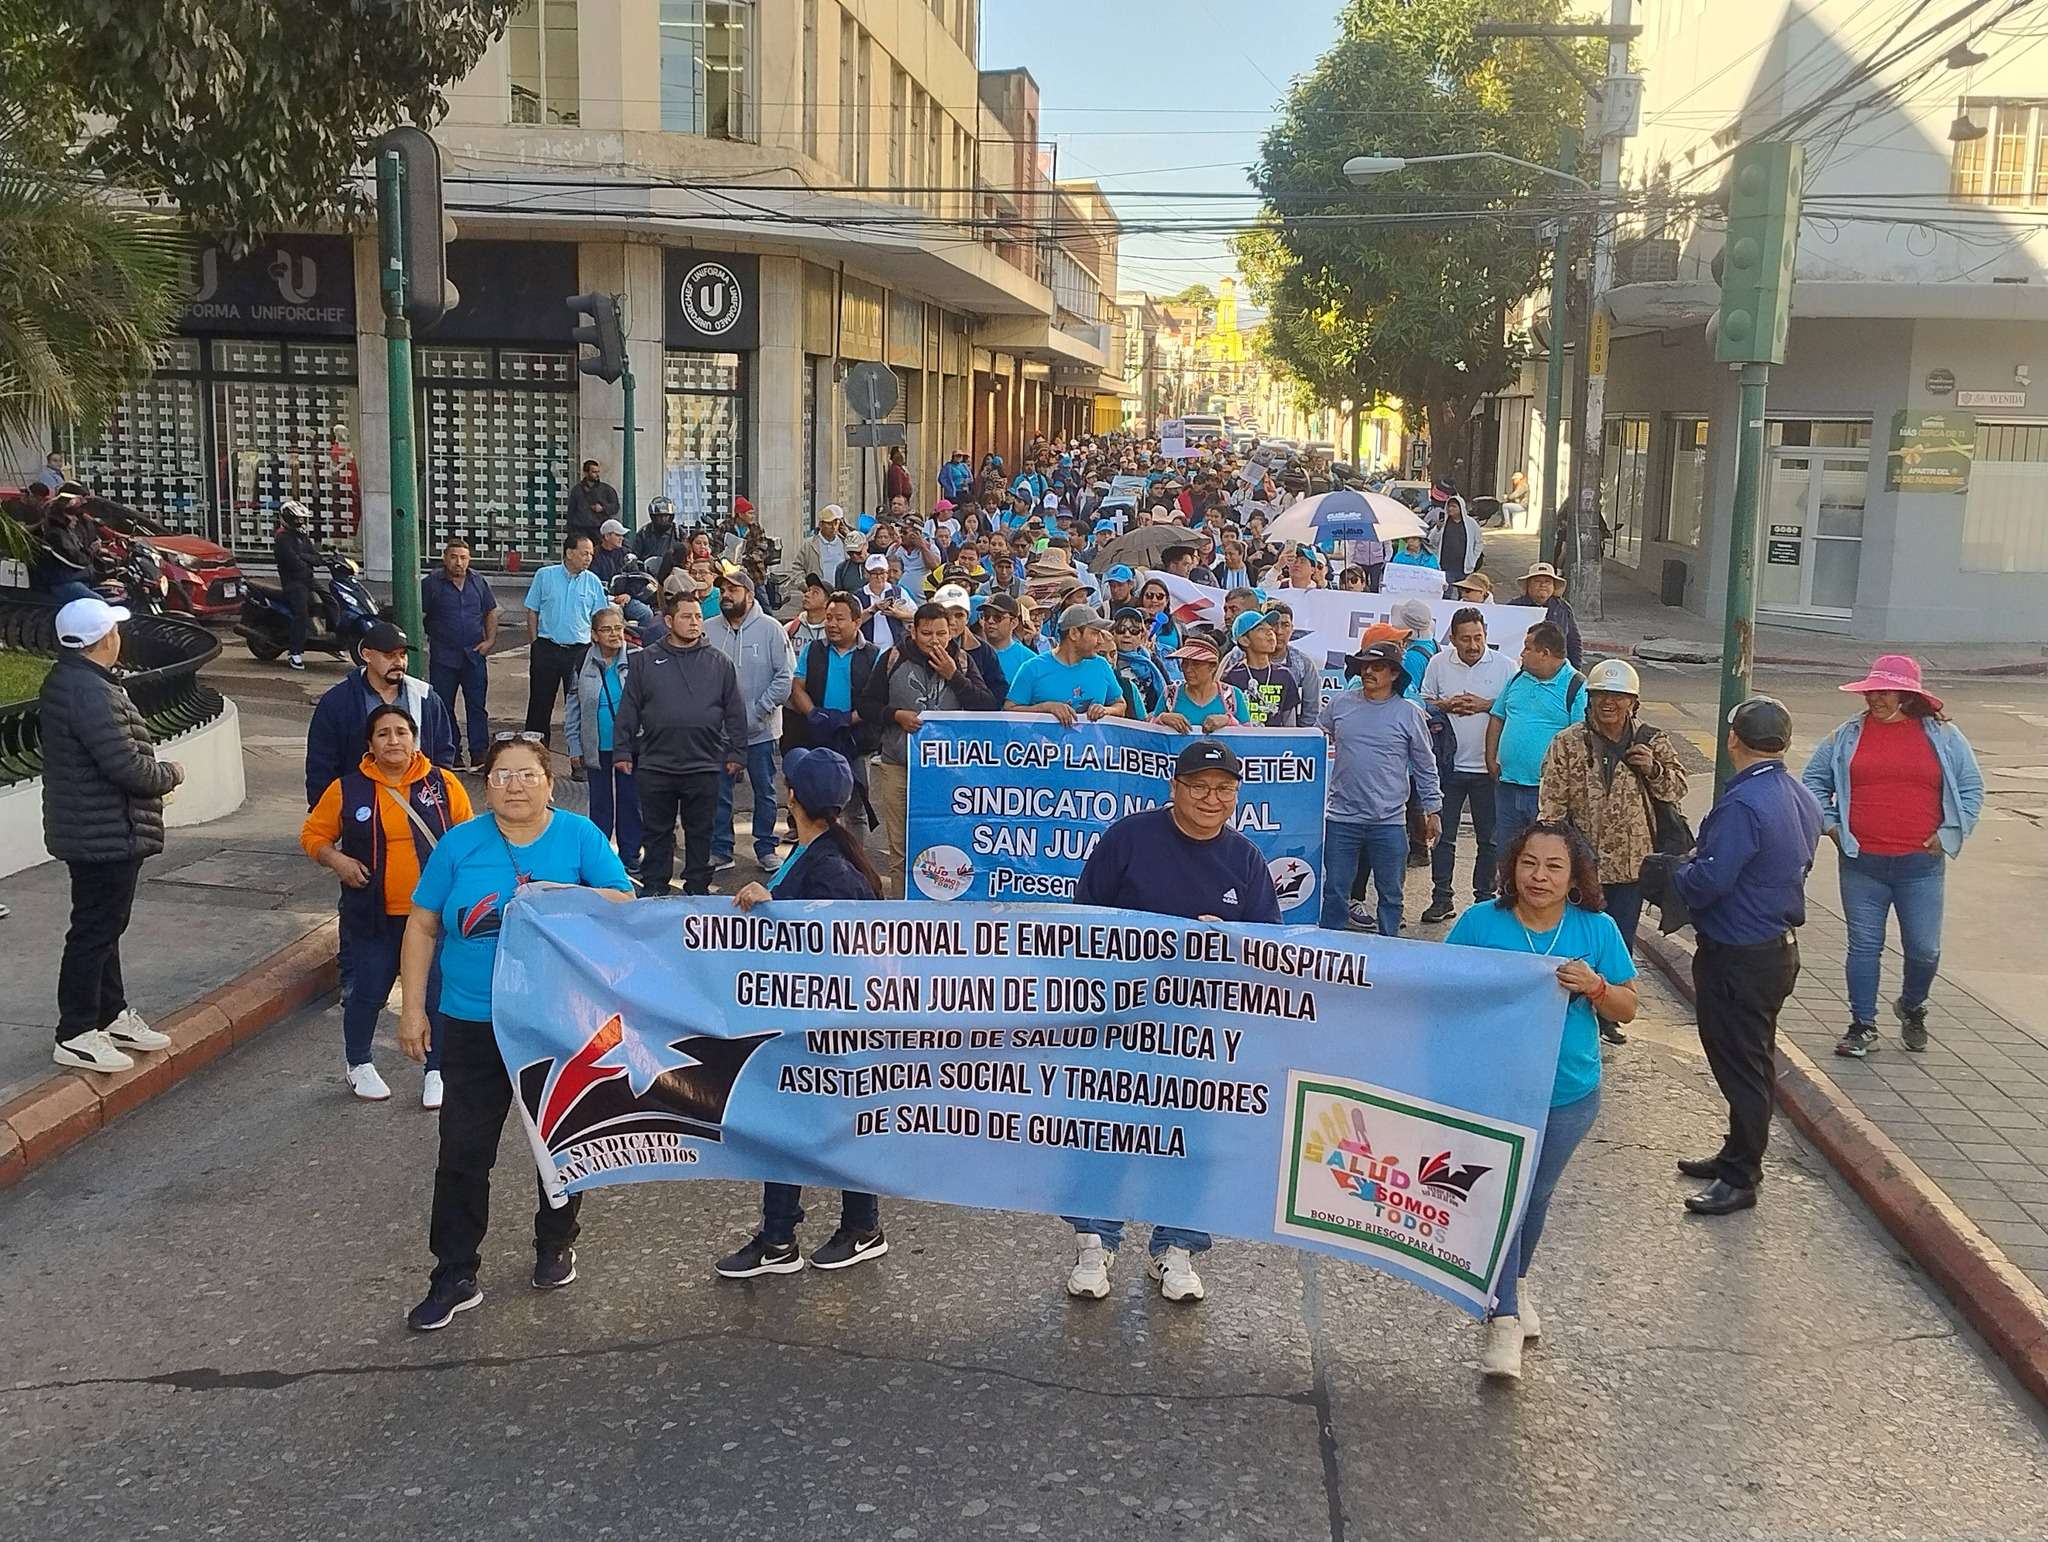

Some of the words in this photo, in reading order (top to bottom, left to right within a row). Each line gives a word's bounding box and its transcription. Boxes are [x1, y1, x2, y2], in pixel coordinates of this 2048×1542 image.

[691, 267, 730, 284] UNIFORMA
[251, 305, 345, 322] UNIFORCHEF
[684, 282, 712, 330] UNIFORCHEF
[1259, 685, 1283, 694] GET
[920, 740, 1000, 768] FILIAL
[1004, 741, 1060, 769] CAP
[1064, 744, 1101, 771] LA
[1103, 745, 1178, 780] LIBERT
[952, 786, 1117, 821] SINDICATO
[972, 824, 1038, 858] SAN
[1044, 828, 1101, 860] JUA
[988, 867, 1080, 898] ¡Presen
[685, 915, 824, 954] SINDICATO
[832, 920, 968, 957] NACIONAL
[975, 920, 1010, 957] DE
[1017, 921, 1178, 961] EMPLEADOS
[1184, 930, 1236, 963] DEL
[1242, 936, 1373, 989] HOSPITAL
[737, 971, 858, 1012] GENERAL
[864, 976, 920, 1012] SAN
[927, 976, 995, 1012] JUAN
[1003, 976, 1038, 1013] DE
[1045, 977, 1106, 1013] DIOS
[1113, 979, 1149, 1014] DE
[1154, 975, 1317, 1023] GUATEMALA
[807, 1028, 962, 1056] MINISTERIO
[970, 1028, 1005, 1050] DE
[1012, 1026, 1098, 1050] SALUD
[1104, 1021, 1216, 1062] PUBLICA
[1222, 1029, 1242, 1063] Y
[778, 1062, 932, 1098] ASISTENCIA
[939, 1061, 1032, 1096] SOCIAL
[1039, 1064, 1058, 1097] Y
[1063, 1066, 1270, 1116] TRABAJADORES
[570, 1133, 679, 1163] SINDICATO
[856, 1106, 890, 1137] DE
[896, 1104, 980, 1137] SALUD
[987, 1110, 1021, 1143] DE
[1028, 1114, 1187, 1159] GUATEMALA
[557, 1162, 590, 1185] SAN
[592, 1150, 633, 1172] JUAN
[637, 1150, 658, 1164] DE
[662, 1149, 697, 1164] DIOS
[1304, 1142, 1411, 1190] SALUD
[1374, 1203, 1447, 1244] TODOS
[1375, 1183, 1450, 1227] SOMOS
[1310, 1209, 1345, 1226] BONO
[1347, 1217, 1363, 1230] DE
[1365, 1222, 1406, 1243] RIESGO
[1408, 1236, 1435, 1254] PARA
[1437, 1247, 1472, 1271] TODOS
